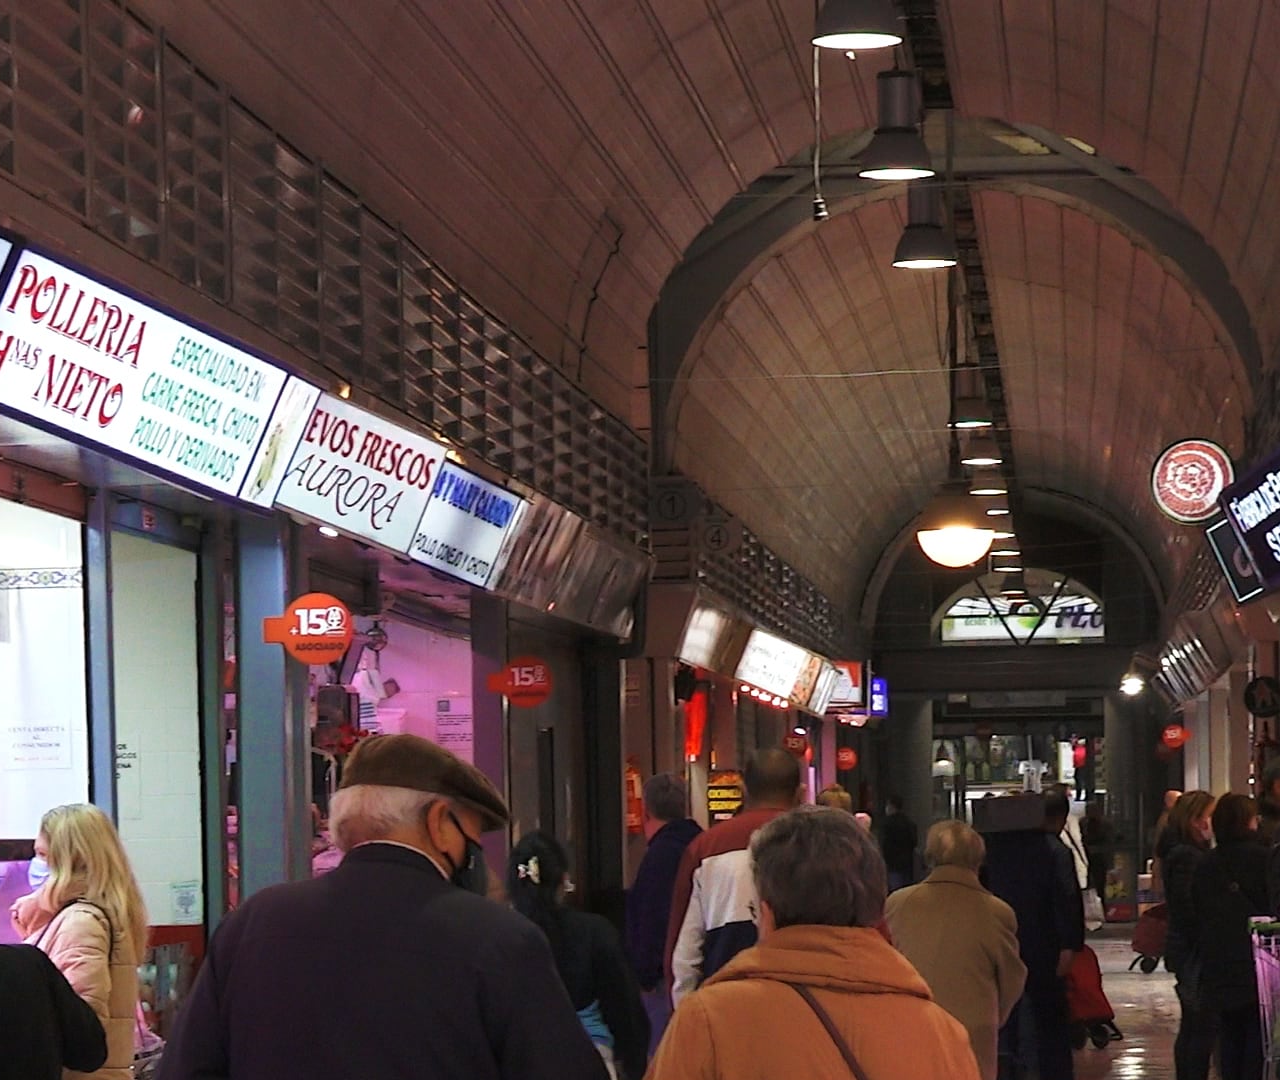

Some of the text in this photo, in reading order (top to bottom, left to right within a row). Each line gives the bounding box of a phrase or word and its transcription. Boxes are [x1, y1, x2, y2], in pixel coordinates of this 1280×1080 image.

[6, 264, 147, 369] POLLERIA
[31, 353, 124, 429] NIETO
[141, 372, 185, 413] CARNE
[170, 335, 251, 395] ESPECIALIDAD
[129, 415, 172, 456] POLLO
[175, 435, 241, 482] DERIVADOS
[355, 430, 436, 490] FRESCOS
[283, 453, 405, 531] AURORA
